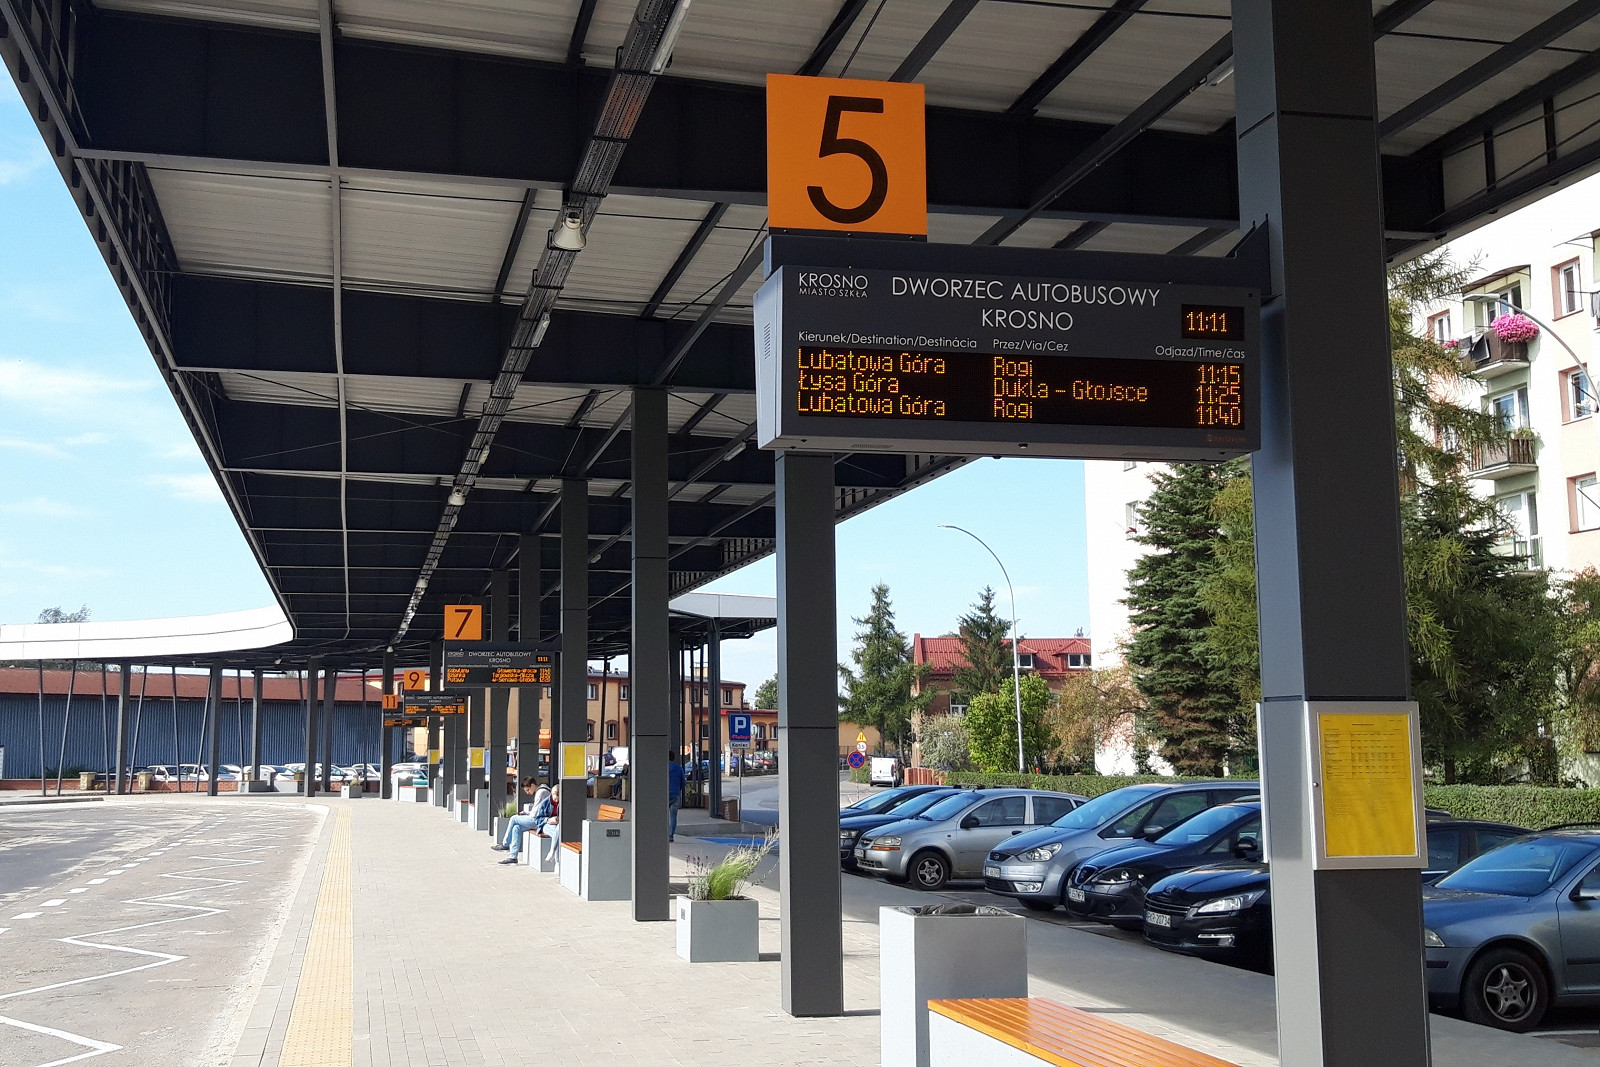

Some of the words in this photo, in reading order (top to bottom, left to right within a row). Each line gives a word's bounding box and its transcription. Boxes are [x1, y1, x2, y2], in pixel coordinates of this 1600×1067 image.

[807, 95, 888, 224] 5
[799, 272, 869, 290] KROSNO
[892, 276, 1004, 300] DWORZEC
[1010, 283, 1161, 307] AUTOBUSOWY
[799, 287, 836, 297] MIASTO
[839, 289, 868, 298] SZKŁA
[982, 309, 1074, 331] KROSNO
[1186, 311, 1227, 332] 11:11
[798, 331, 978, 349] Kierunek/Destination/Destinácia
[993, 338, 1069, 352] Przez/Via/Cez
[798, 348, 893, 372] Lubatowa
[899, 353, 946, 374] Góra
[1155, 345, 1246, 359] Odjazd/Time/čas
[993, 356, 1033, 377] Rogi
[1197, 364, 1240, 385] 11:15
[798, 370, 847, 391] Łysa
[853, 372, 899, 393] Góra
[993, 377, 1049, 399] Dukla
[1072, 380, 1148, 402] Głojsce
[798, 391, 893, 414] Lubatowa
[899, 395, 946, 416] Góra
[1195, 384, 1241, 405] 11:25
[993, 398, 1033, 419] Rogi
[1195, 405, 1241, 426] 11:40
[454, 608, 474, 638] 7
[409, 671, 420, 688] 9
[385, 696, 396, 710] 11
[734, 716, 747, 734] P
